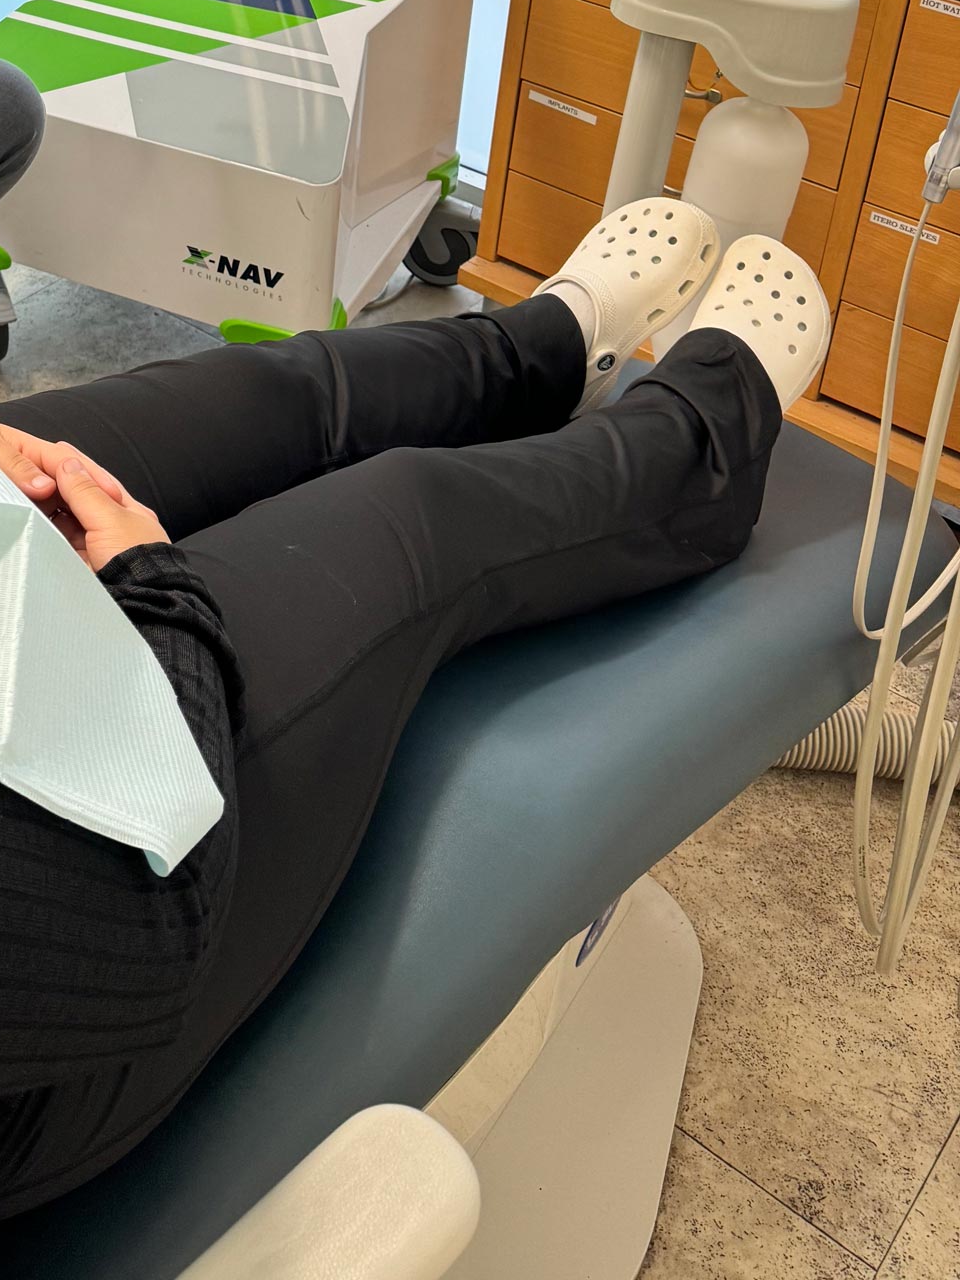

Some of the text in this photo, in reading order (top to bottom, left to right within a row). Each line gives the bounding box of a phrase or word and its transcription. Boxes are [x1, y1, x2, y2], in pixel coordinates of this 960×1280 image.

[547, 99, 579, 116] IMPLANTS
[872, 214, 938, 242] ITERO SLEVES
[181, 266, 283, 302] TECHNOLOGIES
